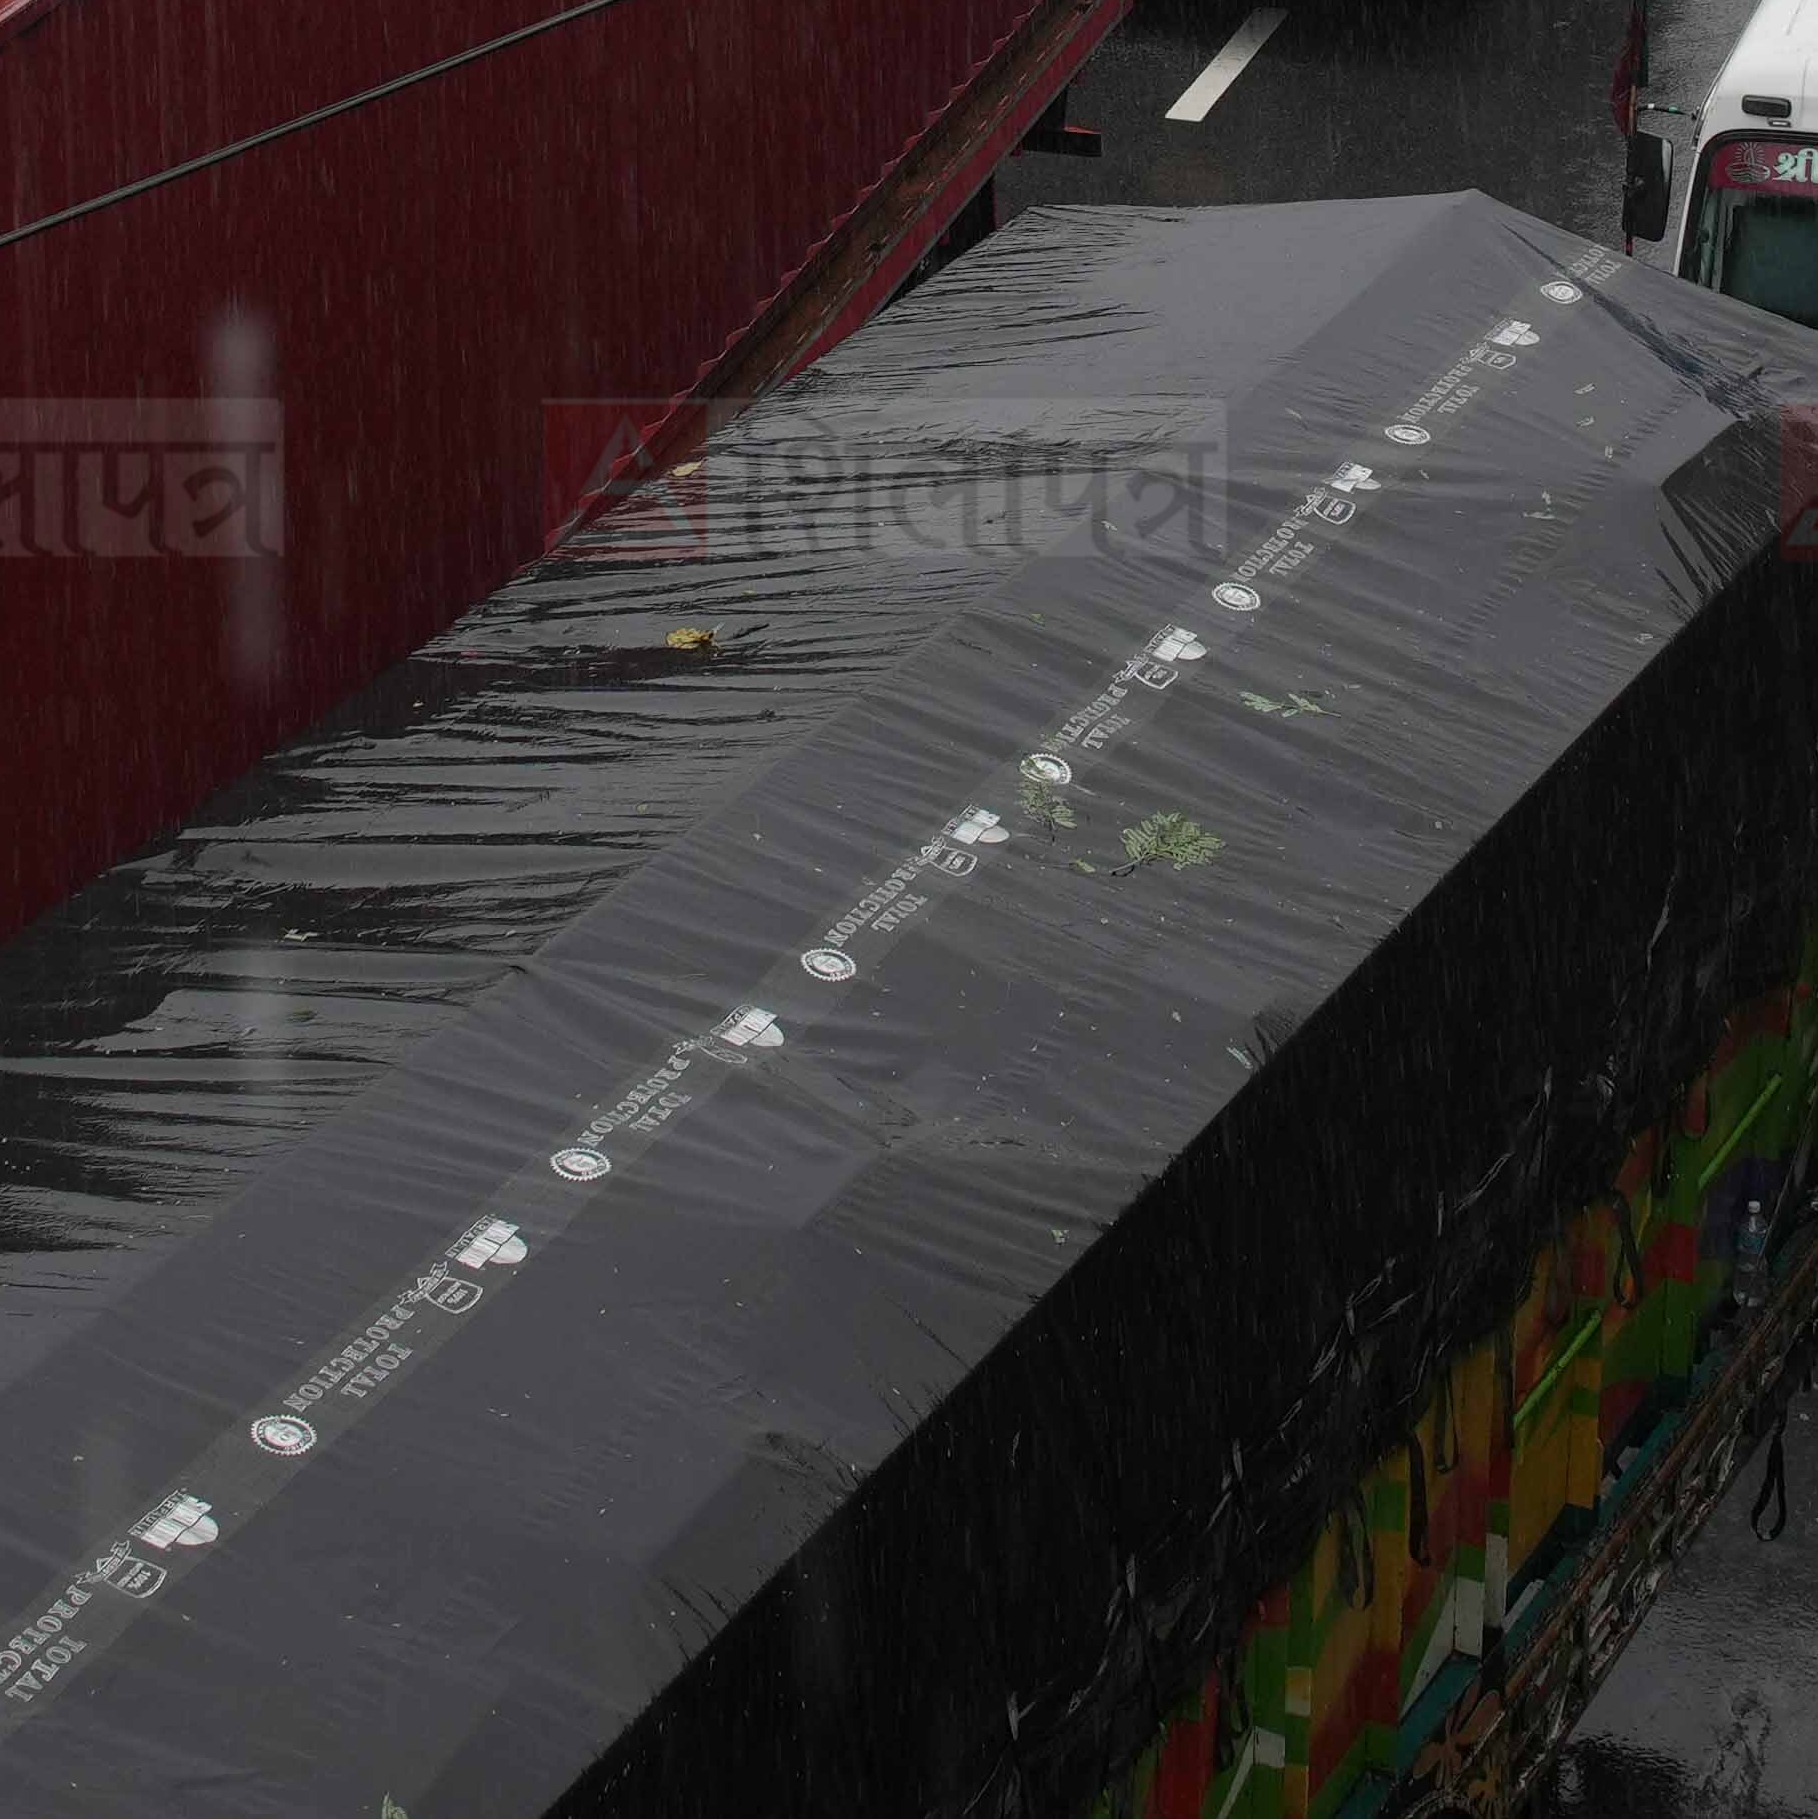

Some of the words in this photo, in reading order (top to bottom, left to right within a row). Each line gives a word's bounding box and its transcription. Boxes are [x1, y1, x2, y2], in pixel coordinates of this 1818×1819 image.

[1268, 541, 1315, 577] TOTAL
[1081, 713, 1132, 750] TOTAL
[871, 893, 928, 933] TOTAL
[577, 1055, 691, 1148] PROTECTION
[628, 1092, 693, 1133] TOTAL
[283, 1304, 415, 1414] PROTECTION
[340, 1343, 414, 1400] TOTAL
[5, 1635, 87, 1703] TOTAL
